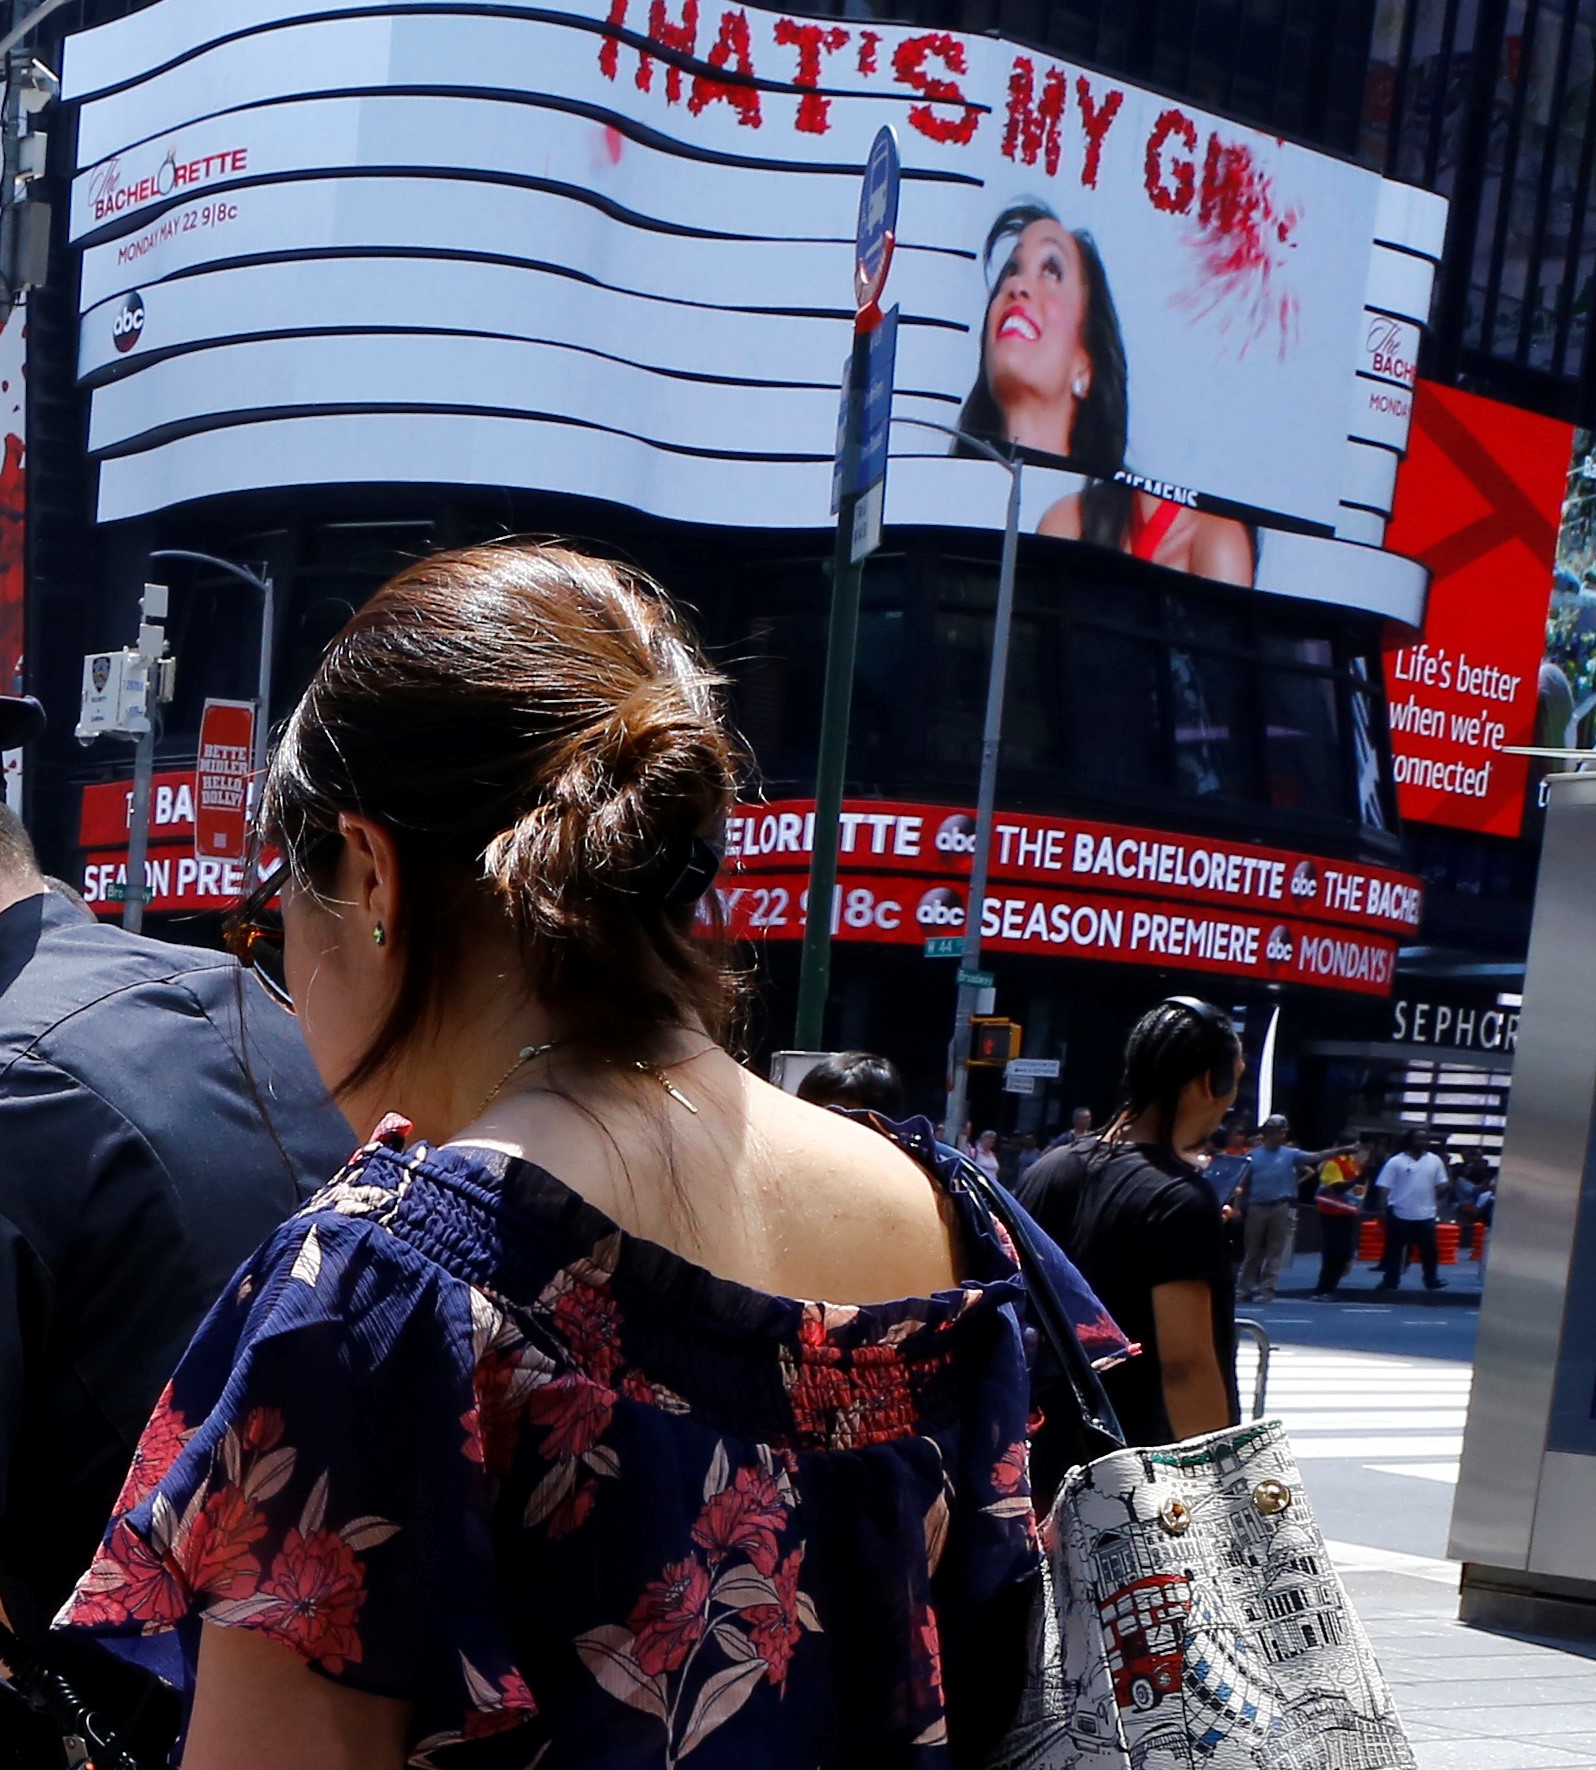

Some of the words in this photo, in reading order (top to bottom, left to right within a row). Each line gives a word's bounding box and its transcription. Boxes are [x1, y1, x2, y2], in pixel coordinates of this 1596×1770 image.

[1004, 54, 1123, 191] MY
[117, 230, 158, 266] MONDAY
[159, 216, 180, 244] MAY
[182, 211, 198, 233] 22
[113, 307, 144, 337] abc
[1367, 316, 1402, 357] The
[1394, 644, 1454, 693] Life's
[1456, 654, 1522, 704] better
[1389, 699, 1446, 744] when
[1451, 708, 1506, 753] we're
[198, 758, 249, 776] MIDLER
[203, 743, 247, 761] BETTE
[1391, 751, 1490, 798] onnected
[995, 823, 1066, 871] THE
[1071, 833, 1287, 900] BACHELORETTE
[1290, 872, 1318, 897] abc
[1324, 870, 1365, 912] THE
[749, 887, 790, 927] 22
[915, 899, 966, 926] abc
[979, 896, 1124, 949] SEASON
[1130, 910, 1261, 966] PREMIERE
[1266, 935, 1293, 961] abc
[1298, 934, 1388, 984] MONDAYS
[938, 940, 953, 953] 44
